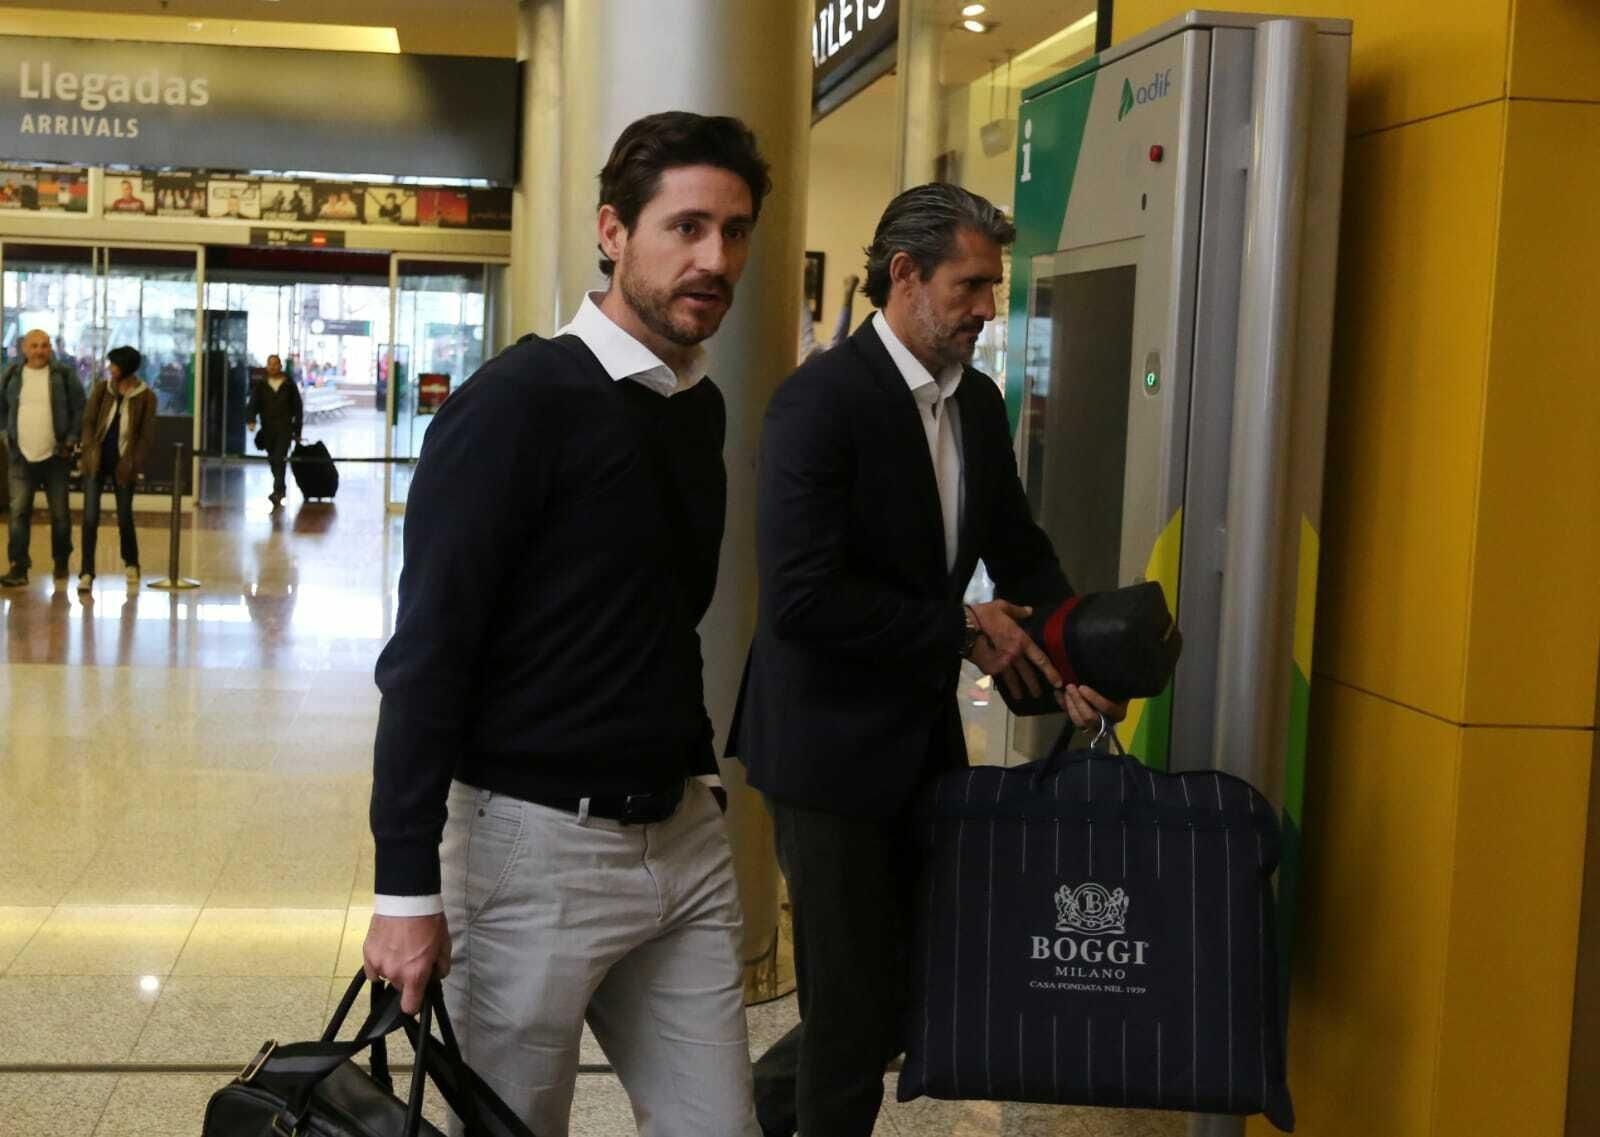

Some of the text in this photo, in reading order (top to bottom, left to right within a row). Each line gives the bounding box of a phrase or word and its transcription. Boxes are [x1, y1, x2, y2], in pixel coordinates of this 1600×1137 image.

[19, 61, 210, 111] Llegadas
[1136, 68, 1172, 104] adif
[20, 113, 140, 138] ARRIVALS
[1030, 935, 1148, 965] BOGGI
[1029, 980, 1055, 989] CASA
[1057, 982, 1102, 992] FONDATA
[1055, 966, 1126, 980] MILANO
